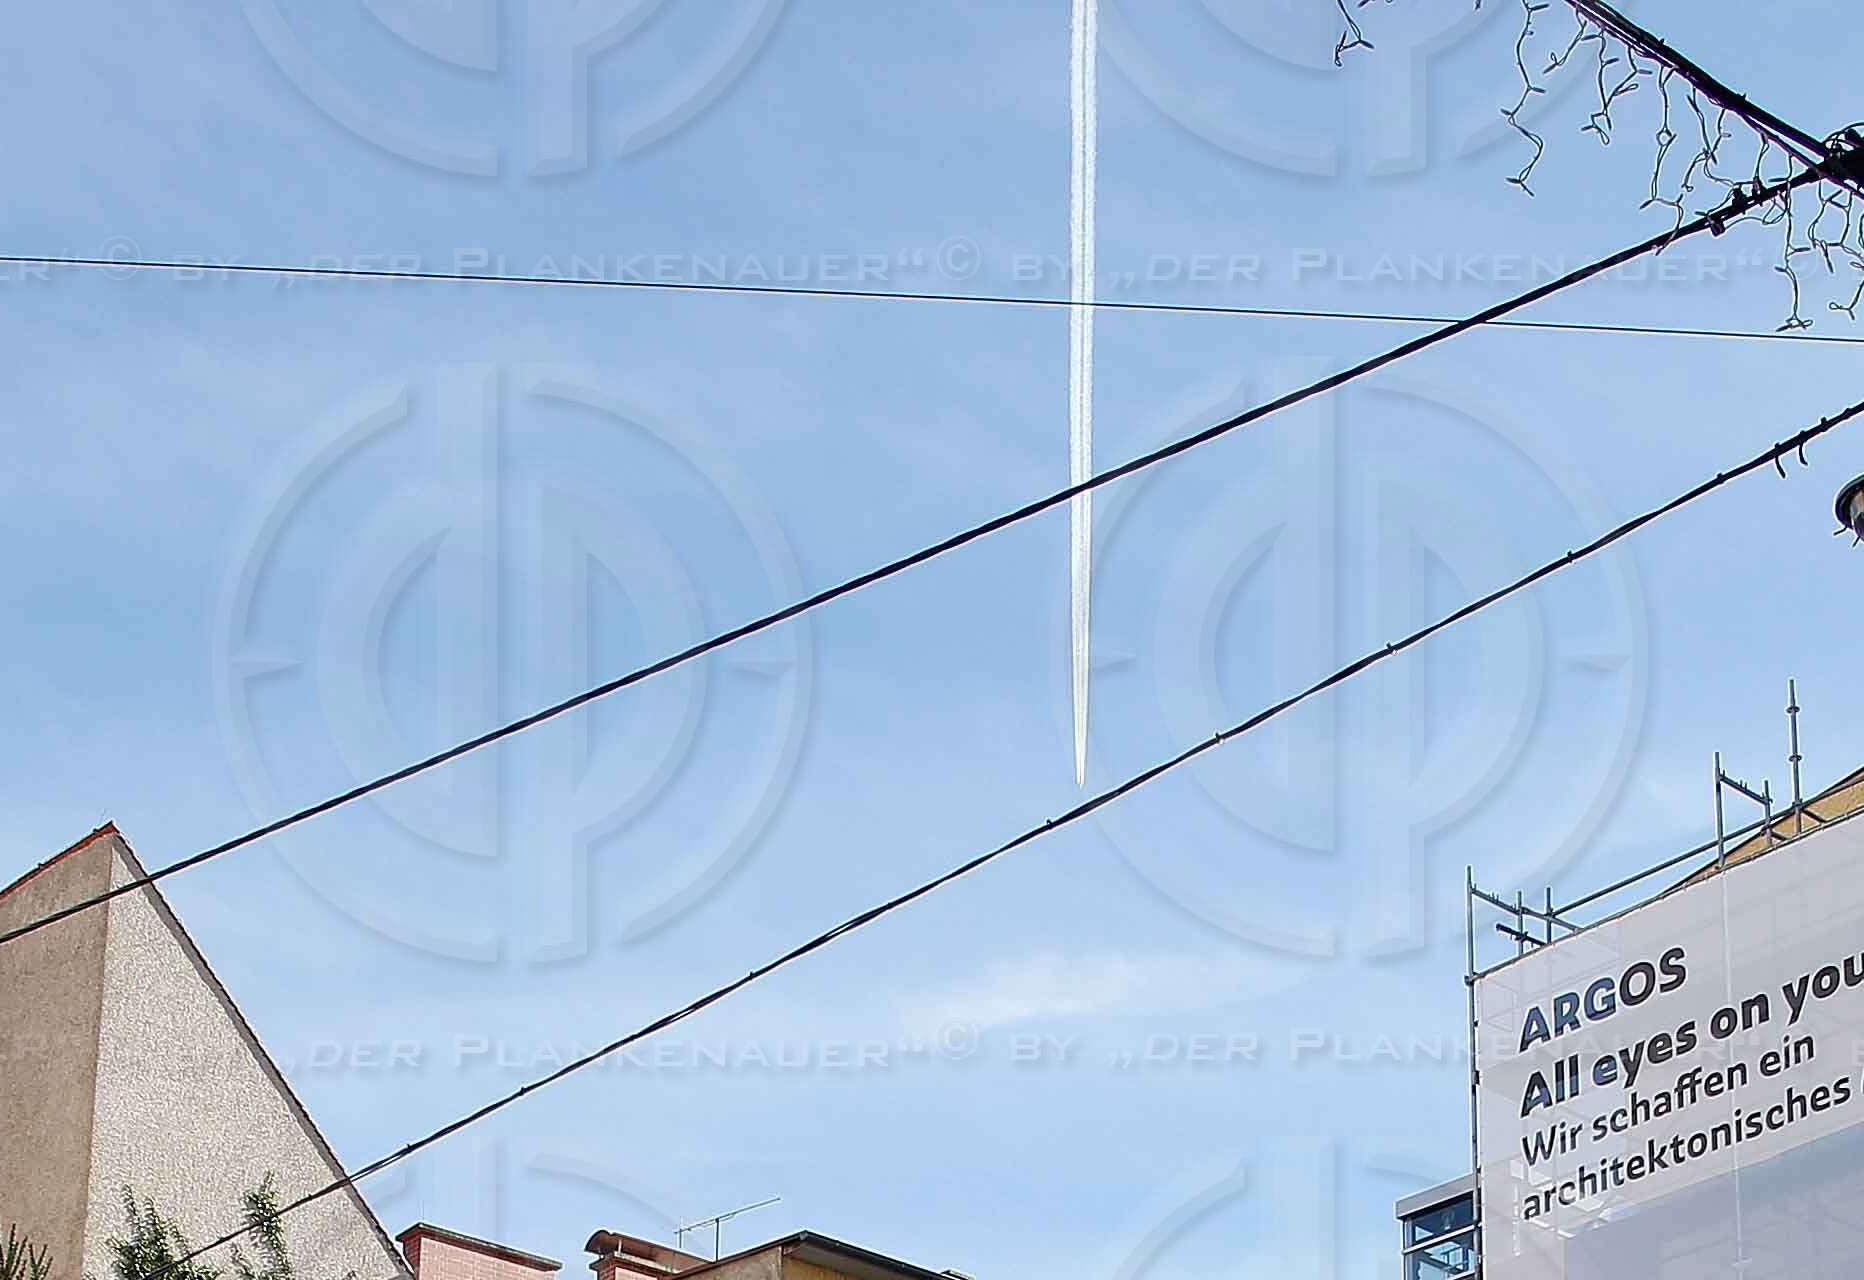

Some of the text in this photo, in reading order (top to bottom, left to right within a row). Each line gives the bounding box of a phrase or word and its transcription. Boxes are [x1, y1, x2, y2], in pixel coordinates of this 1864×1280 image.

[1519, 947, 1687, 1053] ARGOS
[1520, 1054, 1579, 1117] All
[1592, 1020, 1697, 1088] eyes
[1709, 992, 1771, 1040] on
[1522, 1034, 1816, 1167] Wir schaffen ein
[1522, 1076, 1851, 1220] architektonisches
